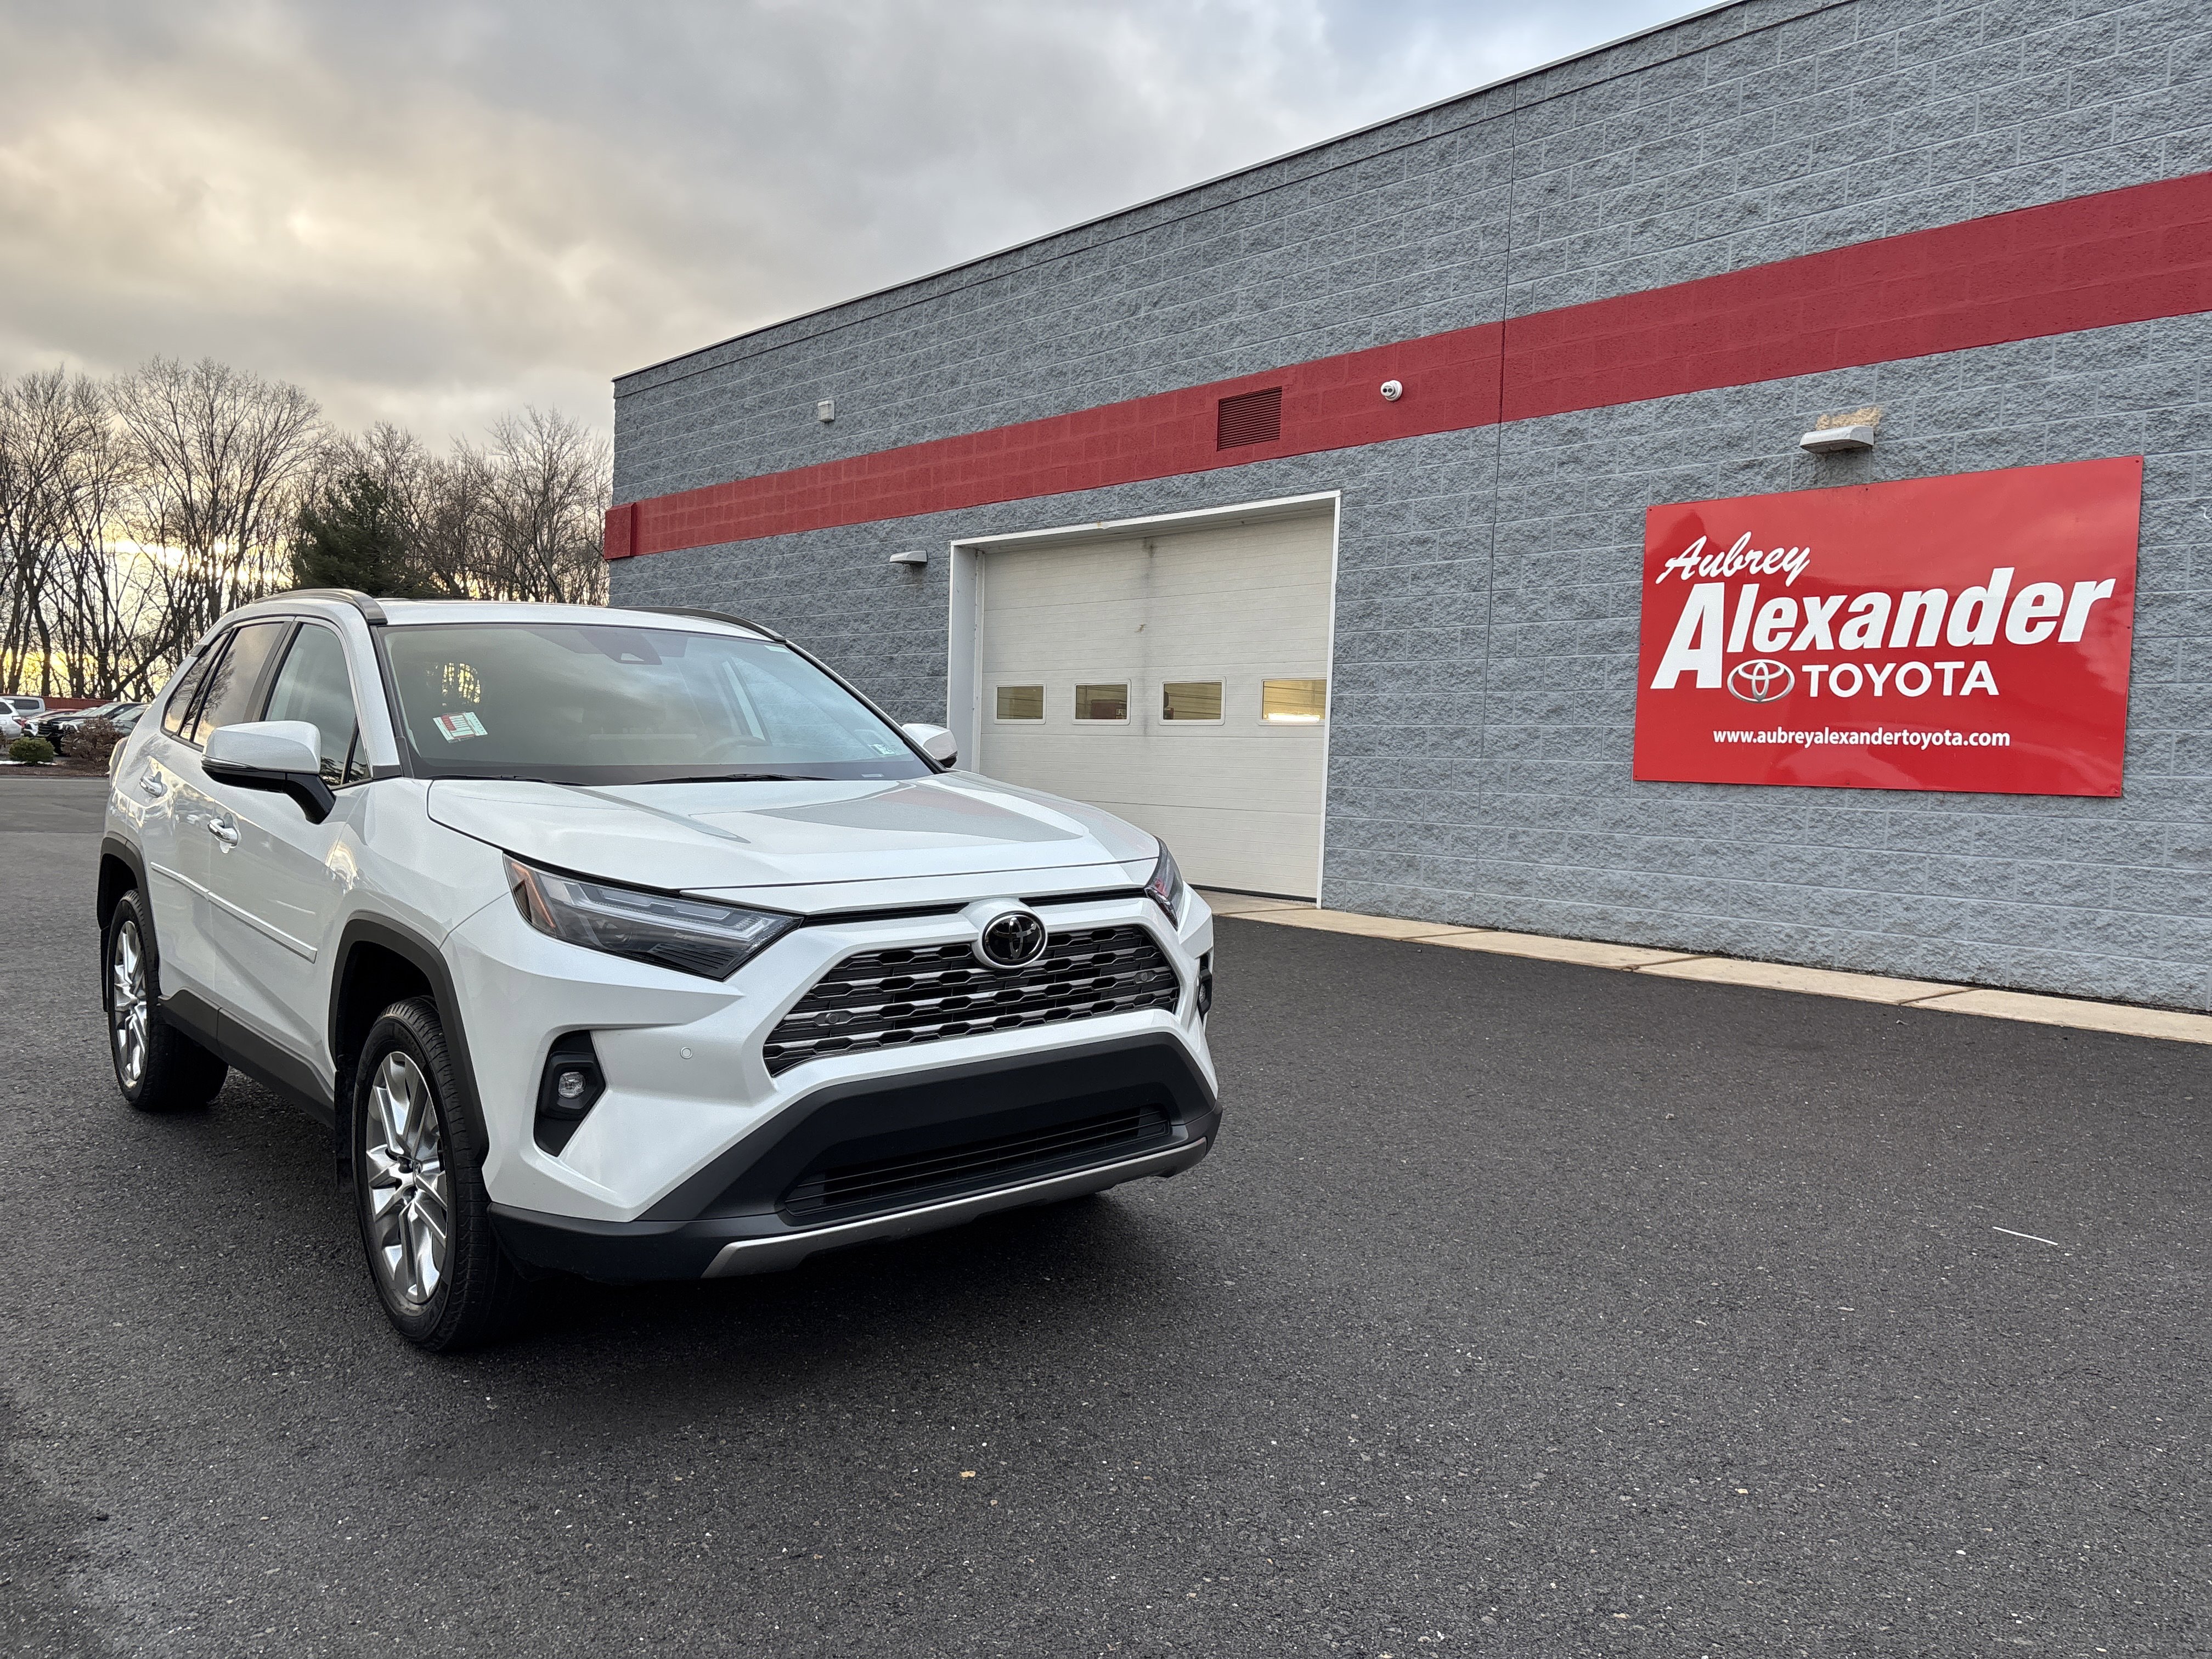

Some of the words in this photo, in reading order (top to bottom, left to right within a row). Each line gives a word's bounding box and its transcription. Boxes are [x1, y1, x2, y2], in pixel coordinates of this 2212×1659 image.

[1656, 531, 1811, 587] Aubrey
[1650, 567, 2117, 690] Alexander
[1802, 661, 1999, 697] TOYOTA
[1713, 726, 2011, 751] www.aubreyalexandertoyota.com
